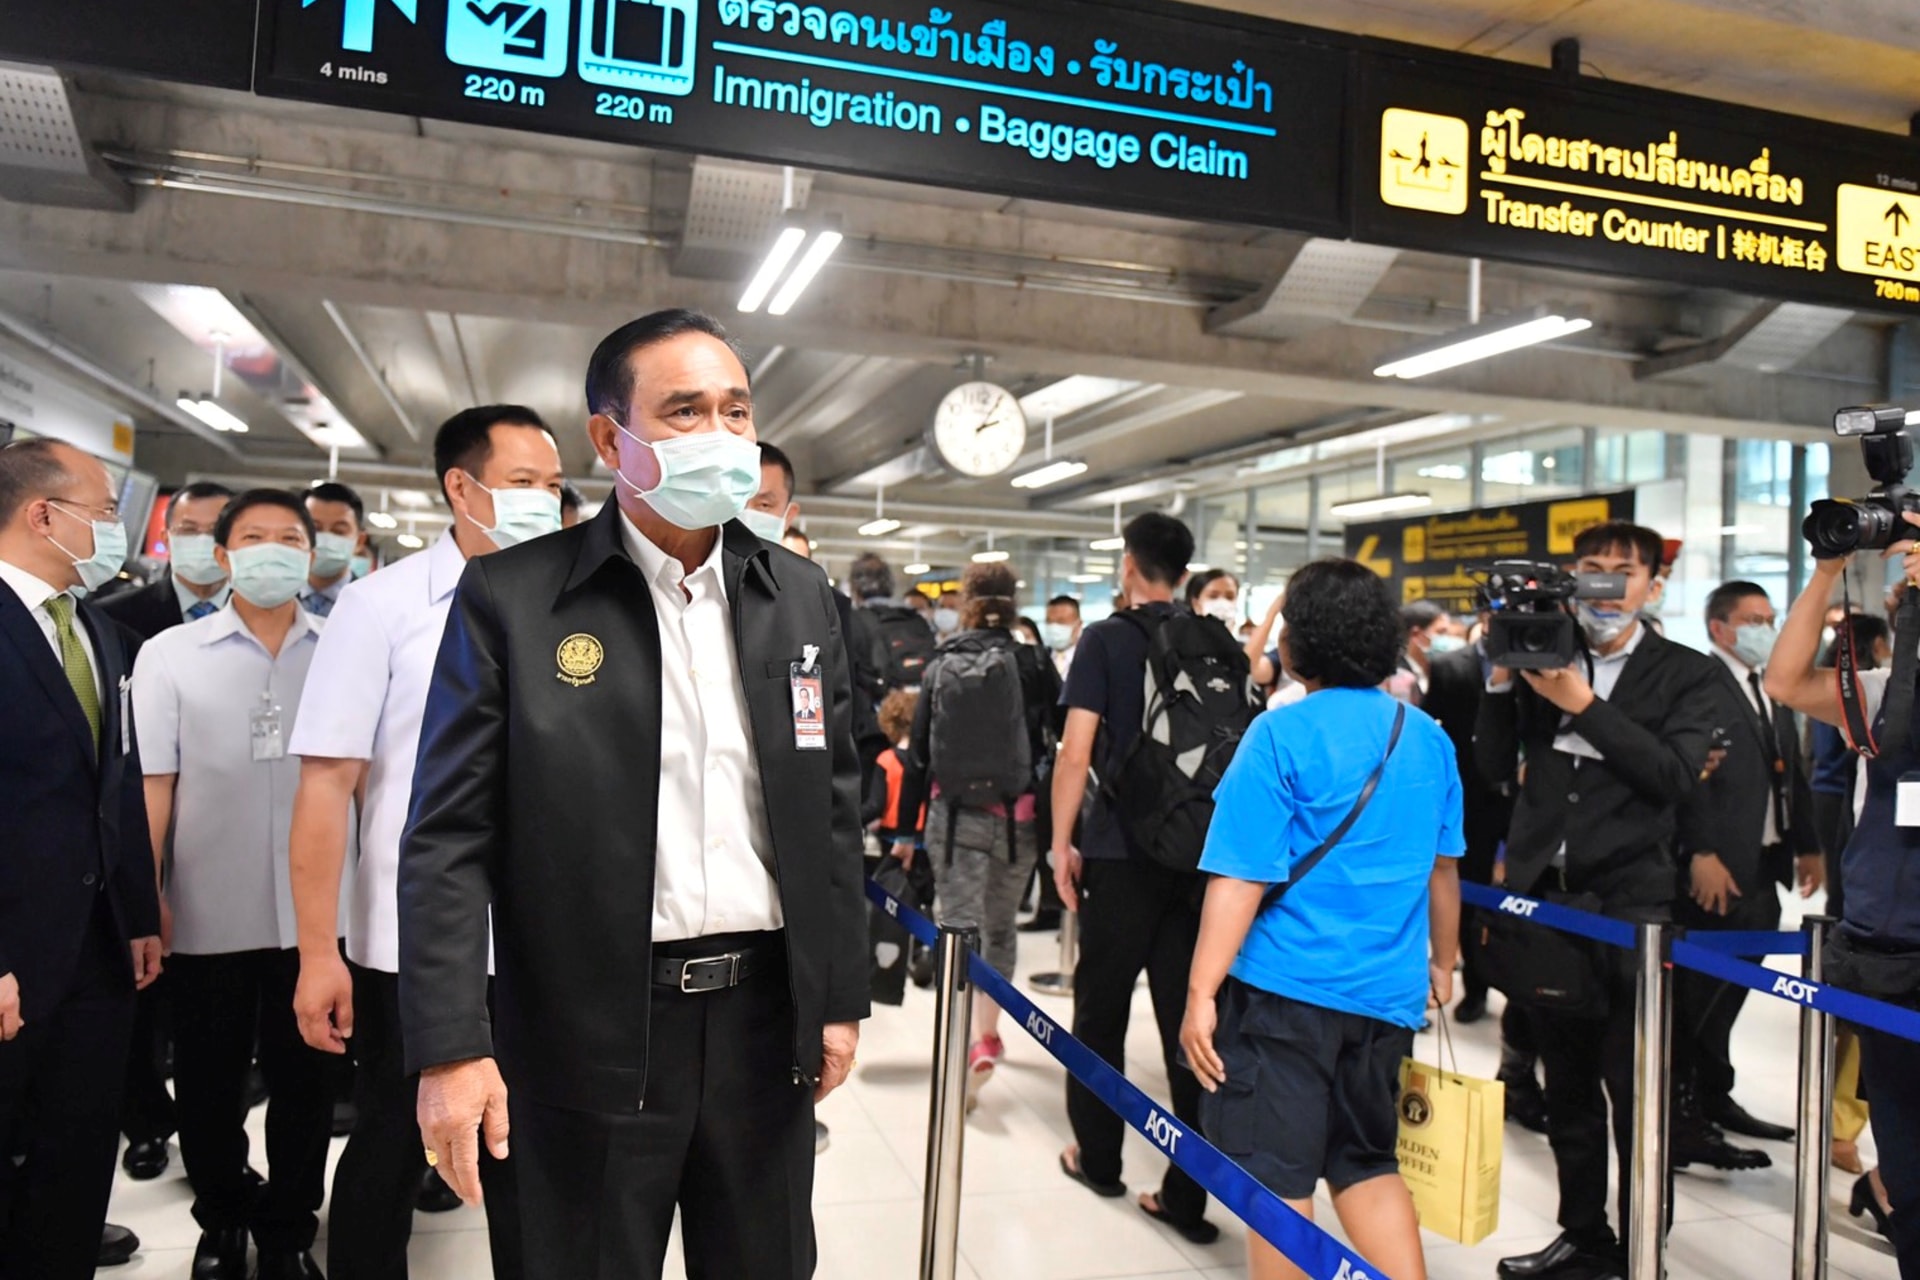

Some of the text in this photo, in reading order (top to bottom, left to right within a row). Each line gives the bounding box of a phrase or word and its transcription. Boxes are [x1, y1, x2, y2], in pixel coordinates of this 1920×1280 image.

[717, 0, 1055, 77] ตรวจคนเข้าเมือง
[320, 62, 388, 84] 4 mins
[463, 74, 545, 107] 220 m
[1090, 39, 1273, 113] รับกระเป๋า
[595, 93, 673, 125] 220 m
[713, 65, 1249, 180] Immigration Baggage Claim
[1480, 108, 1803, 206] ผู้โดยสารเปลี่ยนเครื่อง
[1480, 189, 1711, 254] Transfer Counter
[1865, 240, 1920, 272] EAS
[1499, 895, 1539, 917] AOT
[1772, 976, 1819, 1004] AOT
[1026, 1010, 1055, 1045] AOT
[1144, 1108, 1183, 1155] AOT
